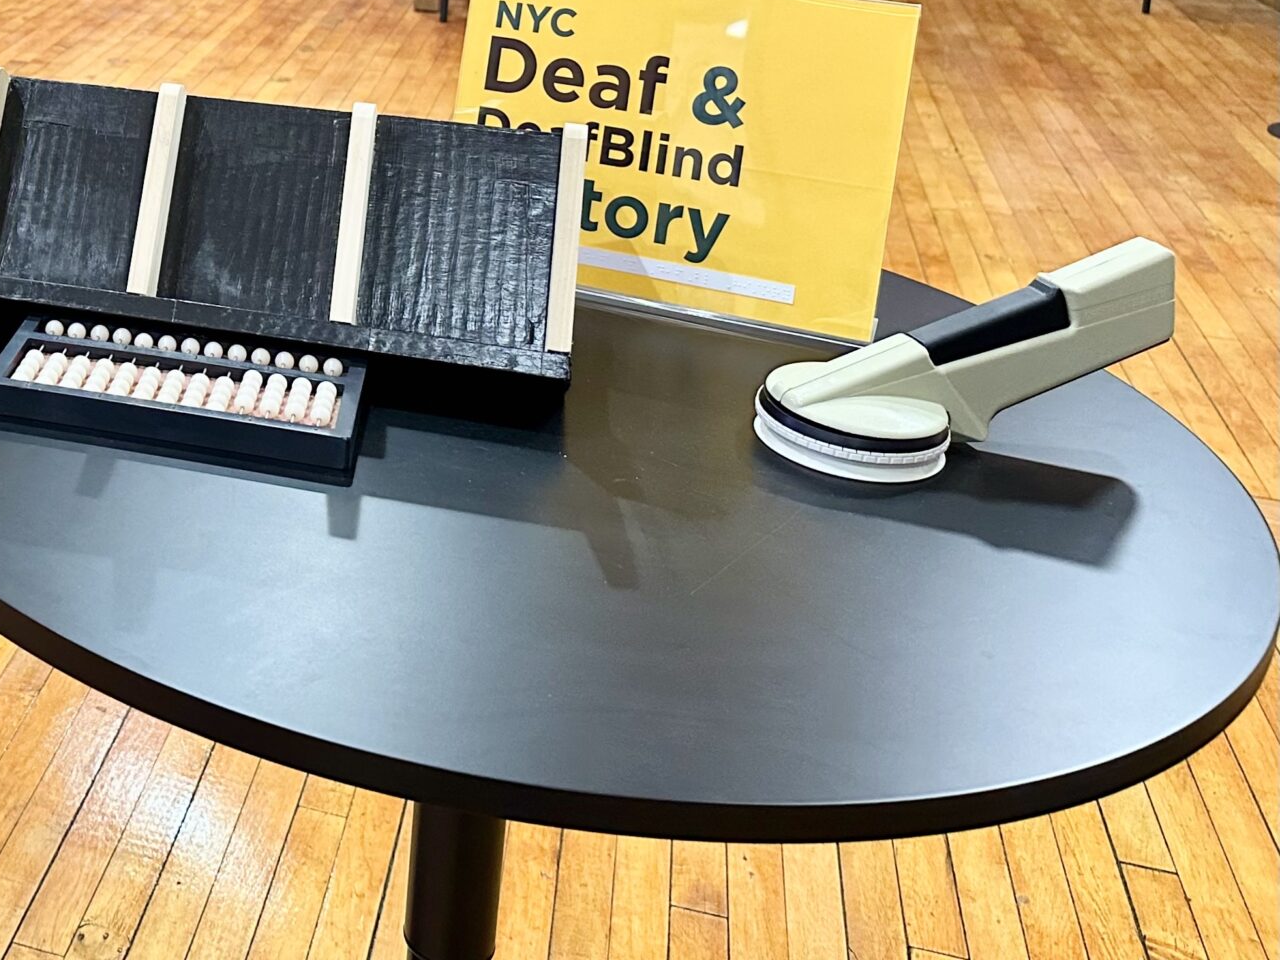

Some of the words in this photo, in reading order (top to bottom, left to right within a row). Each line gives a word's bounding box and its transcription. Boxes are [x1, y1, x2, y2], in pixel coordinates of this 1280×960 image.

[494, 0, 577, 38] NYC
[484, 35, 670, 115] Deaf
[692, 66, 746, 129] &
[579, 178, 730, 264] tory
